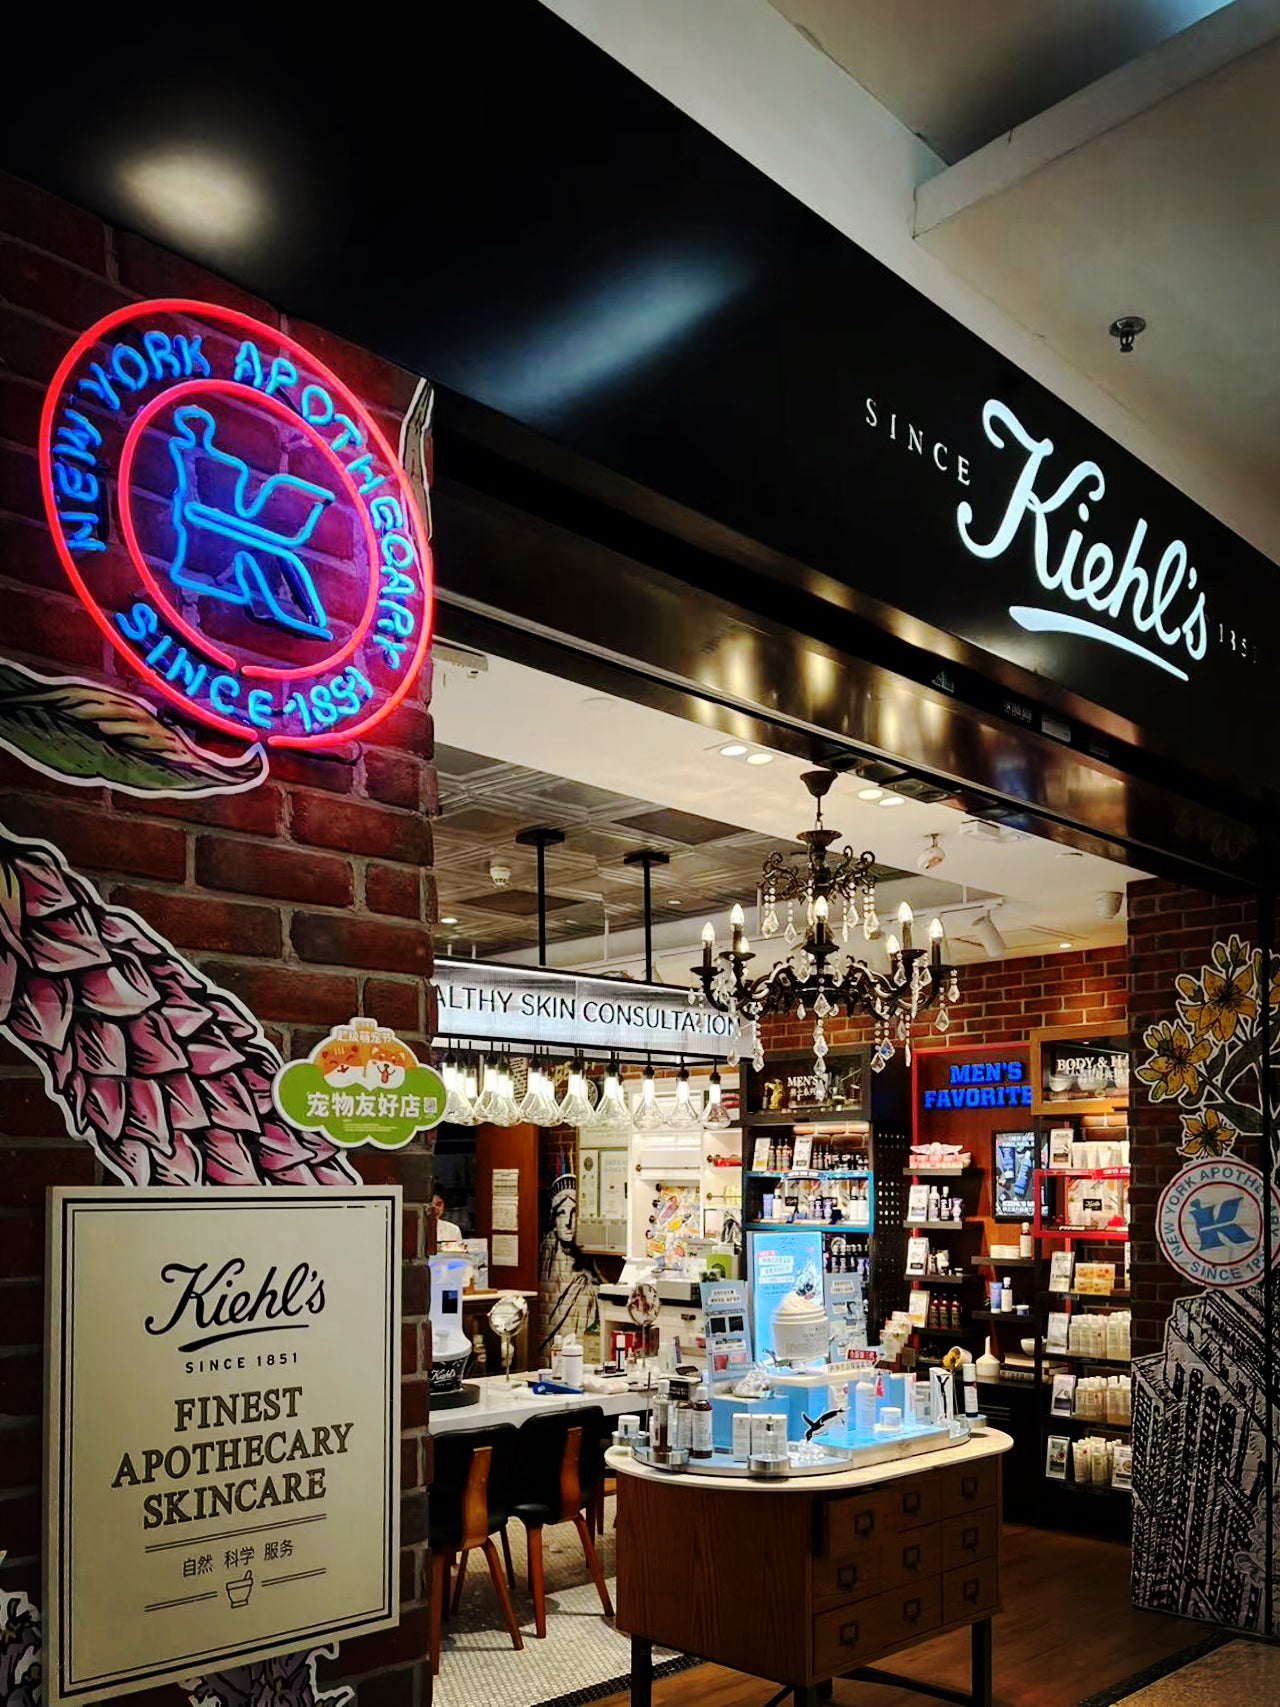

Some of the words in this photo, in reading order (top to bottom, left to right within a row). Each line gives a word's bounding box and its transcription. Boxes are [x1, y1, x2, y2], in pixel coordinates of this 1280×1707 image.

[78, 331, 212, 411] YORK
[865, 397, 970, 486] SINCE
[53, 409, 107, 552] NEW
[234, 341, 417, 670] APOTHECARY
[957, 399, 1208, 662] Kiehl's
[115, 602, 274, 729] SINCE
[285, 664, 374, 733] 1851
[520, 993, 576, 1020] SKIN
[950, 1061, 1023, 1085] MEN'S
[1056, 1057, 1095, 1071] BODY
[1097, 1056, 1109, 1068] &
[306, 1091, 420, 1118] 宠物友好店
[1165, 1175, 1197, 1214] YORK
[1164, 1221, 1184, 1257] NEW
[1190, 1261, 1243, 1281] SINCE
[145, 1258, 326, 1335] Kiehl's
[185, 1357, 245, 1374] SINCE
[256, 1352, 298, 1367] 1851
[174, 1386, 303, 1432] FINEST
[111, 1423, 354, 1488] APOTHECARY
[143, 1467, 327, 1530] SKINCARE
[182, 1554, 214, 1578] 自然
[223, 1546, 255, 1569] 科学
[264, 1538, 295, 1561] 服务
